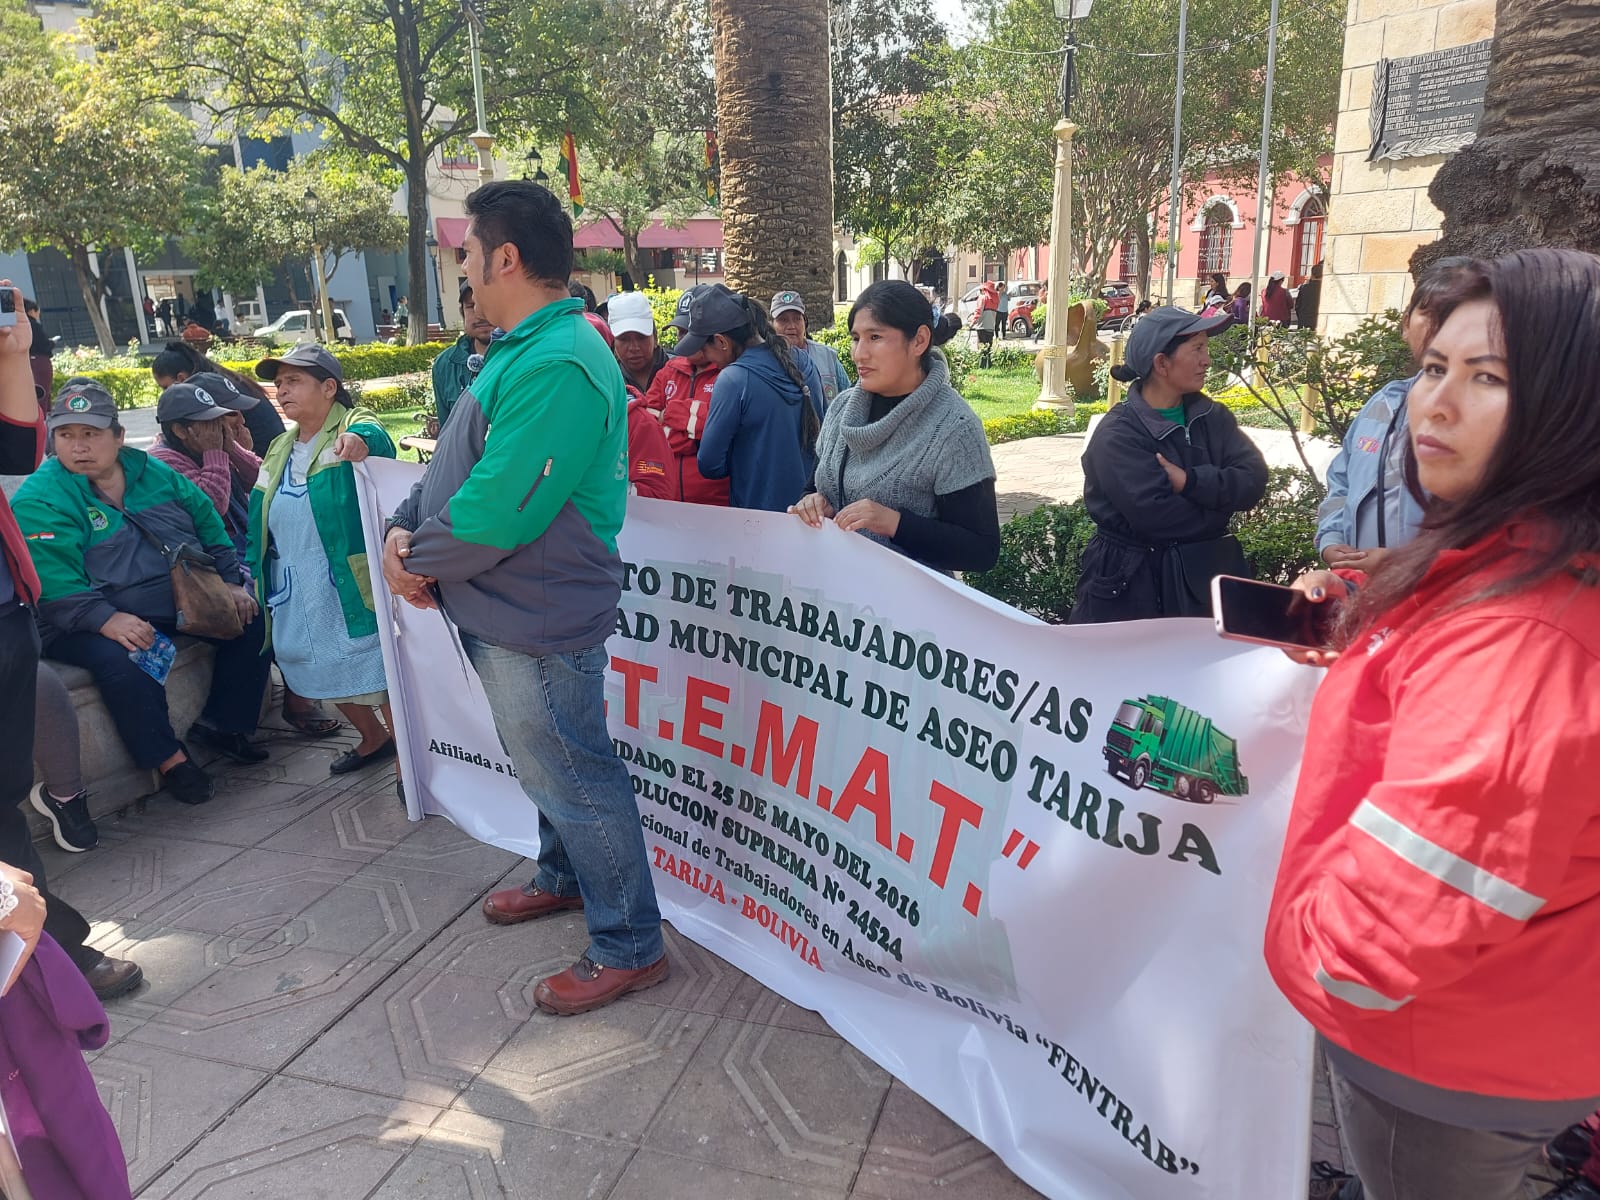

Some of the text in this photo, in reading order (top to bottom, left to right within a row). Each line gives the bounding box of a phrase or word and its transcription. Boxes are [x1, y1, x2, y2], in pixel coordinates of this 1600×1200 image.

[614, 607, 1222, 875] AD MUNICIPAL DE ASEO TARIJA
[621, 562, 1093, 743] TO DE TRABAJADORES/AS
[428, 739, 492, 769] Afiliada
[495, 761, 505, 773] a
[640, 814, 689, 849] cional
[692, 838, 711, 860] de
[715, 847, 819, 930] Trabajadores
[822, 922, 840, 950] en
[841, 938, 891, 978] Aseo
[897, 972, 929, 993] de
[931, 983, 1029, 1044] Bolivia
[630, 774, 719, 831] OLUCION
[722, 816, 818, 891] SUPREMA
[847, 900, 903, 963] 24524
[653, 845, 728, 906] TARIJA
[741, 893, 826, 973] BOLIVIA
[682, 764, 708, 793] EL
[712, 780, 735, 806] 25
[738, 789, 767, 821] DE
[771, 805, 830, 857] MAYO
[833, 842, 872, 890] DEL
[875, 878, 920, 927] 2016
